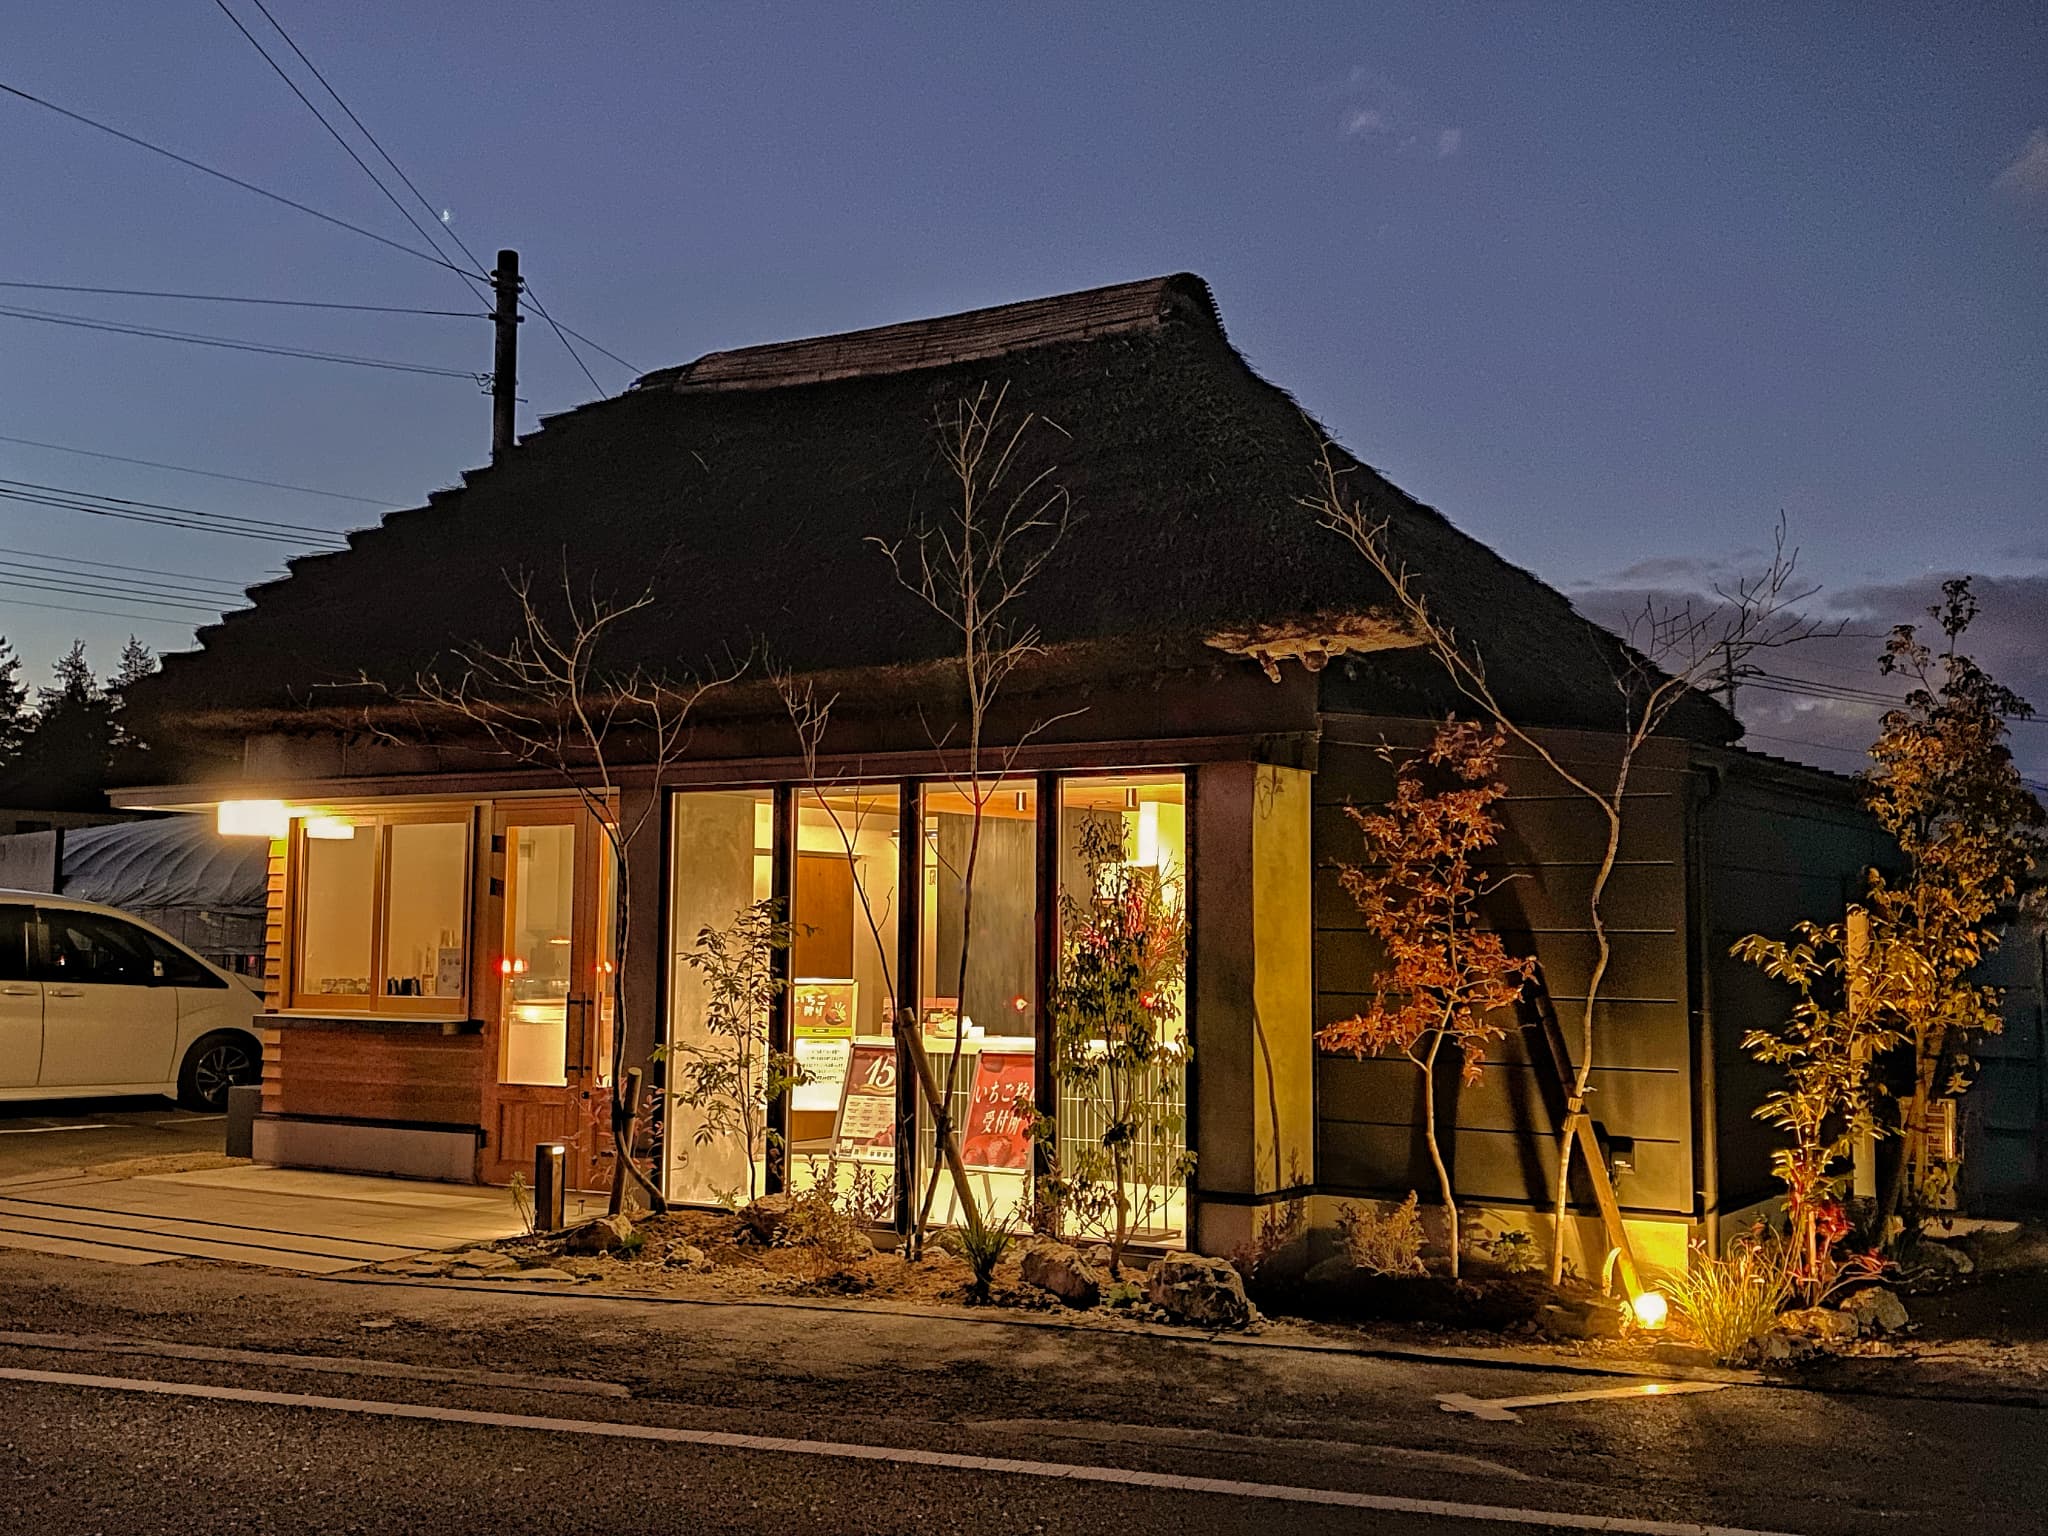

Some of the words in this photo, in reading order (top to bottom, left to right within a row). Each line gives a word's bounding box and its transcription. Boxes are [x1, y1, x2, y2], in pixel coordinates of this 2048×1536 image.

[865, 1055, 896, 1088] 15
[981, 1109, 1021, 1135] 受付所
